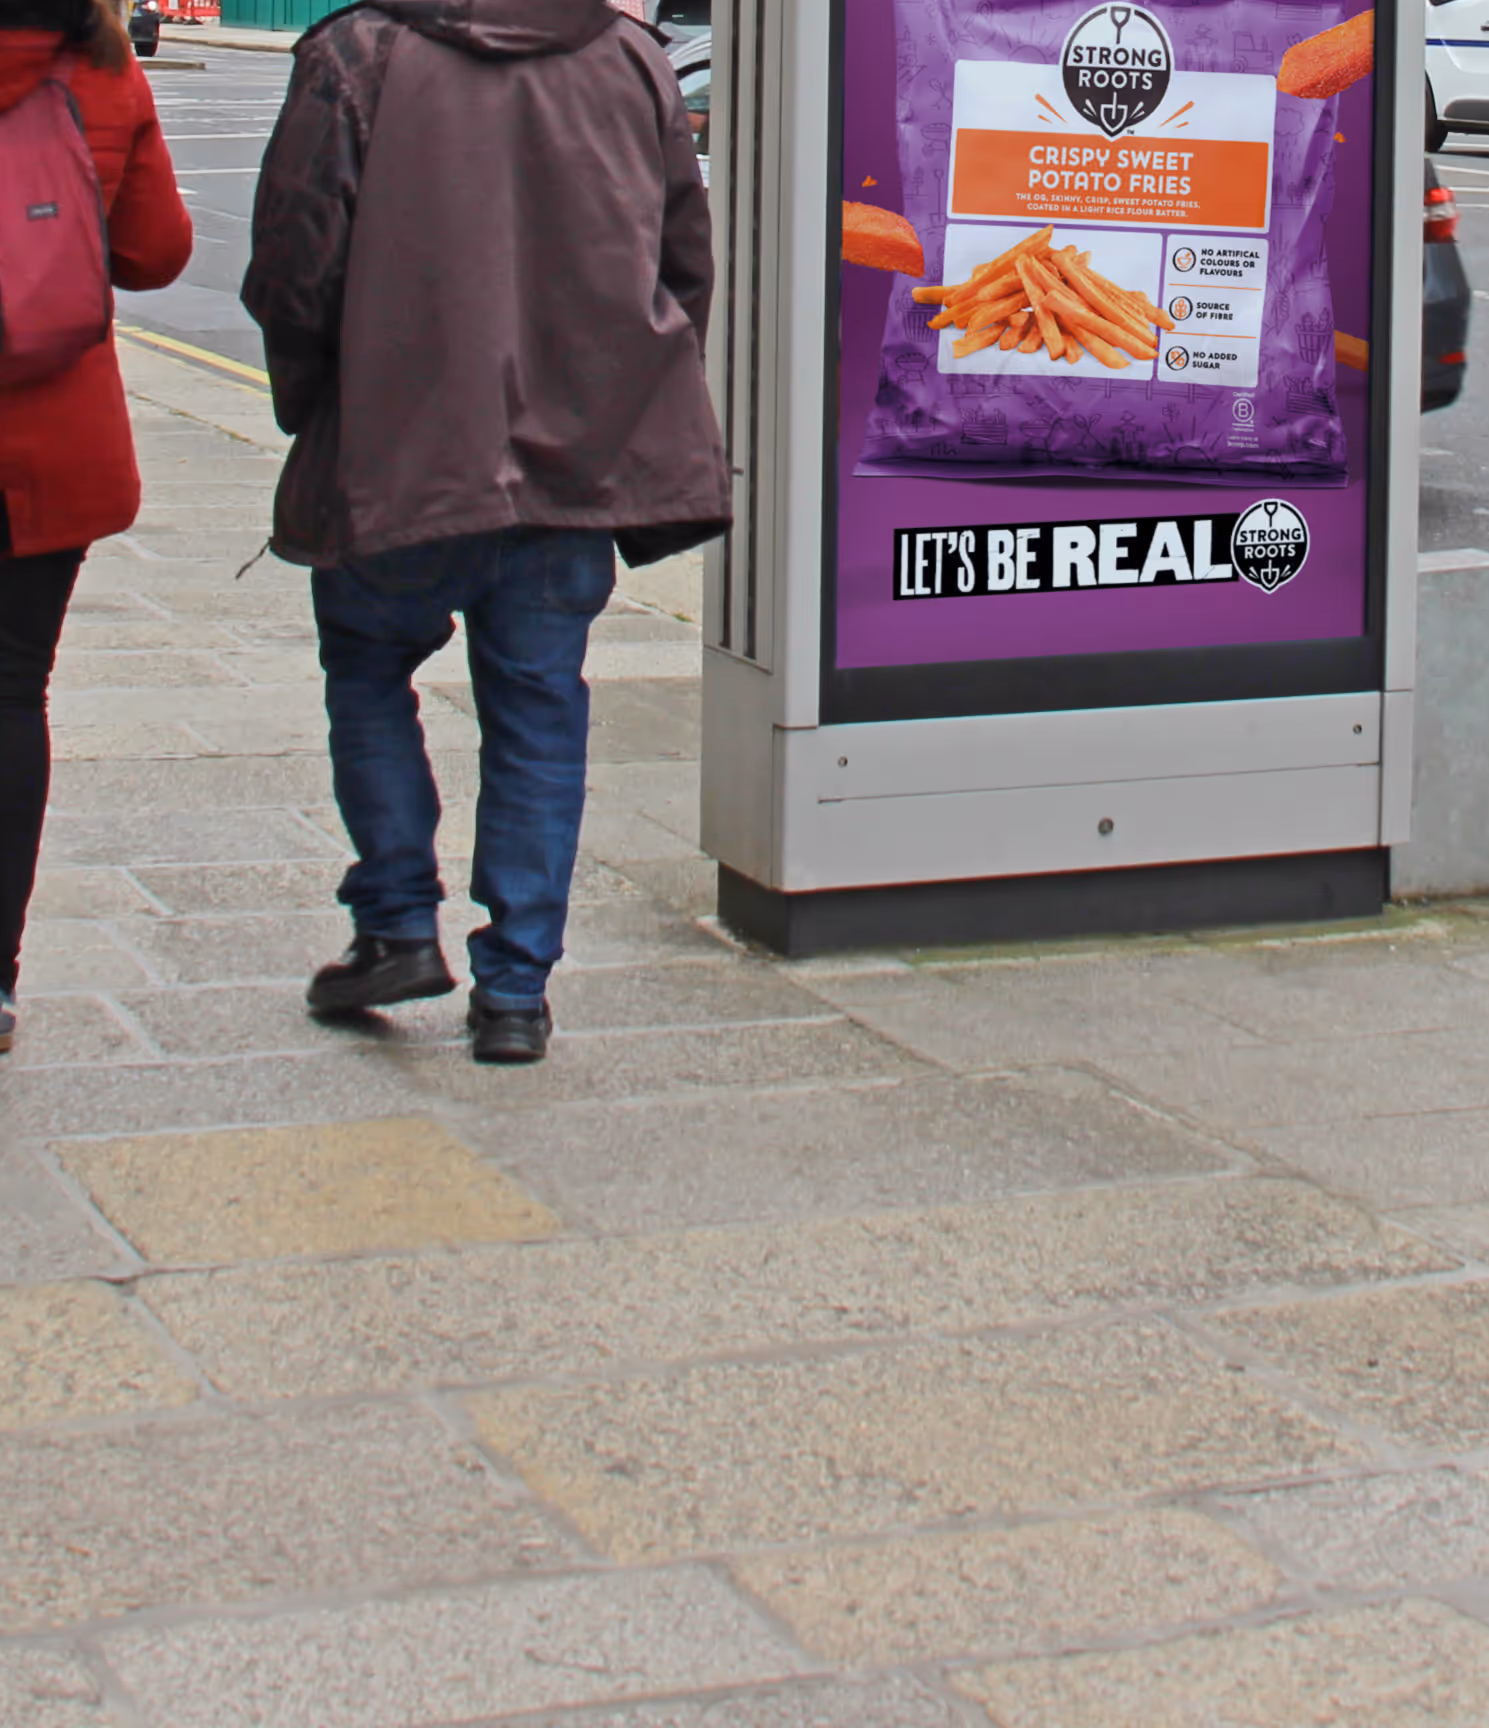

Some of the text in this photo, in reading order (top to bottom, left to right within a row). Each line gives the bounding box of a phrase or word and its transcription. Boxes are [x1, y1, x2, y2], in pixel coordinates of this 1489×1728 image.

[1072, 45, 1163, 68] STRONG
[1078, 69, 1153, 91] ROOTS
[1029, 146, 1194, 172] CRISPY SWEET
[1028, 170, 1192, 195] POTATO FRIES
[1016, 192, 1032, 201] THE
[1113, 198, 1140, 206] SWEET
[1142, 199, 1173, 207] POTATO
[1027, 203, 1059, 211] COATED
[1061, 204, 1071, 212] IN
[1079, 205, 1105, 214] LIGHT
[1106, 207, 1124, 215] RICE
[1127, 208, 1153, 216] FLOUR
[1200, 258, 1255, 268] COLOURS OR
[1199, 268, 1243, 277] FLAVOURS
[1196, 302, 1230, 310] SOURCE
[1210, 312, 1233, 320] FIBRE
[1193, 351, 1237, 361] NO ADDED
[1192, 361, 1220, 369] SUGAR
[1238, 402, 1249, 418] B
[1239, 527, 1303, 545] STRONG
[900, 519, 1233, 596] LET'S BE REAL
[1244, 544, 1297, 559] ROOTS
